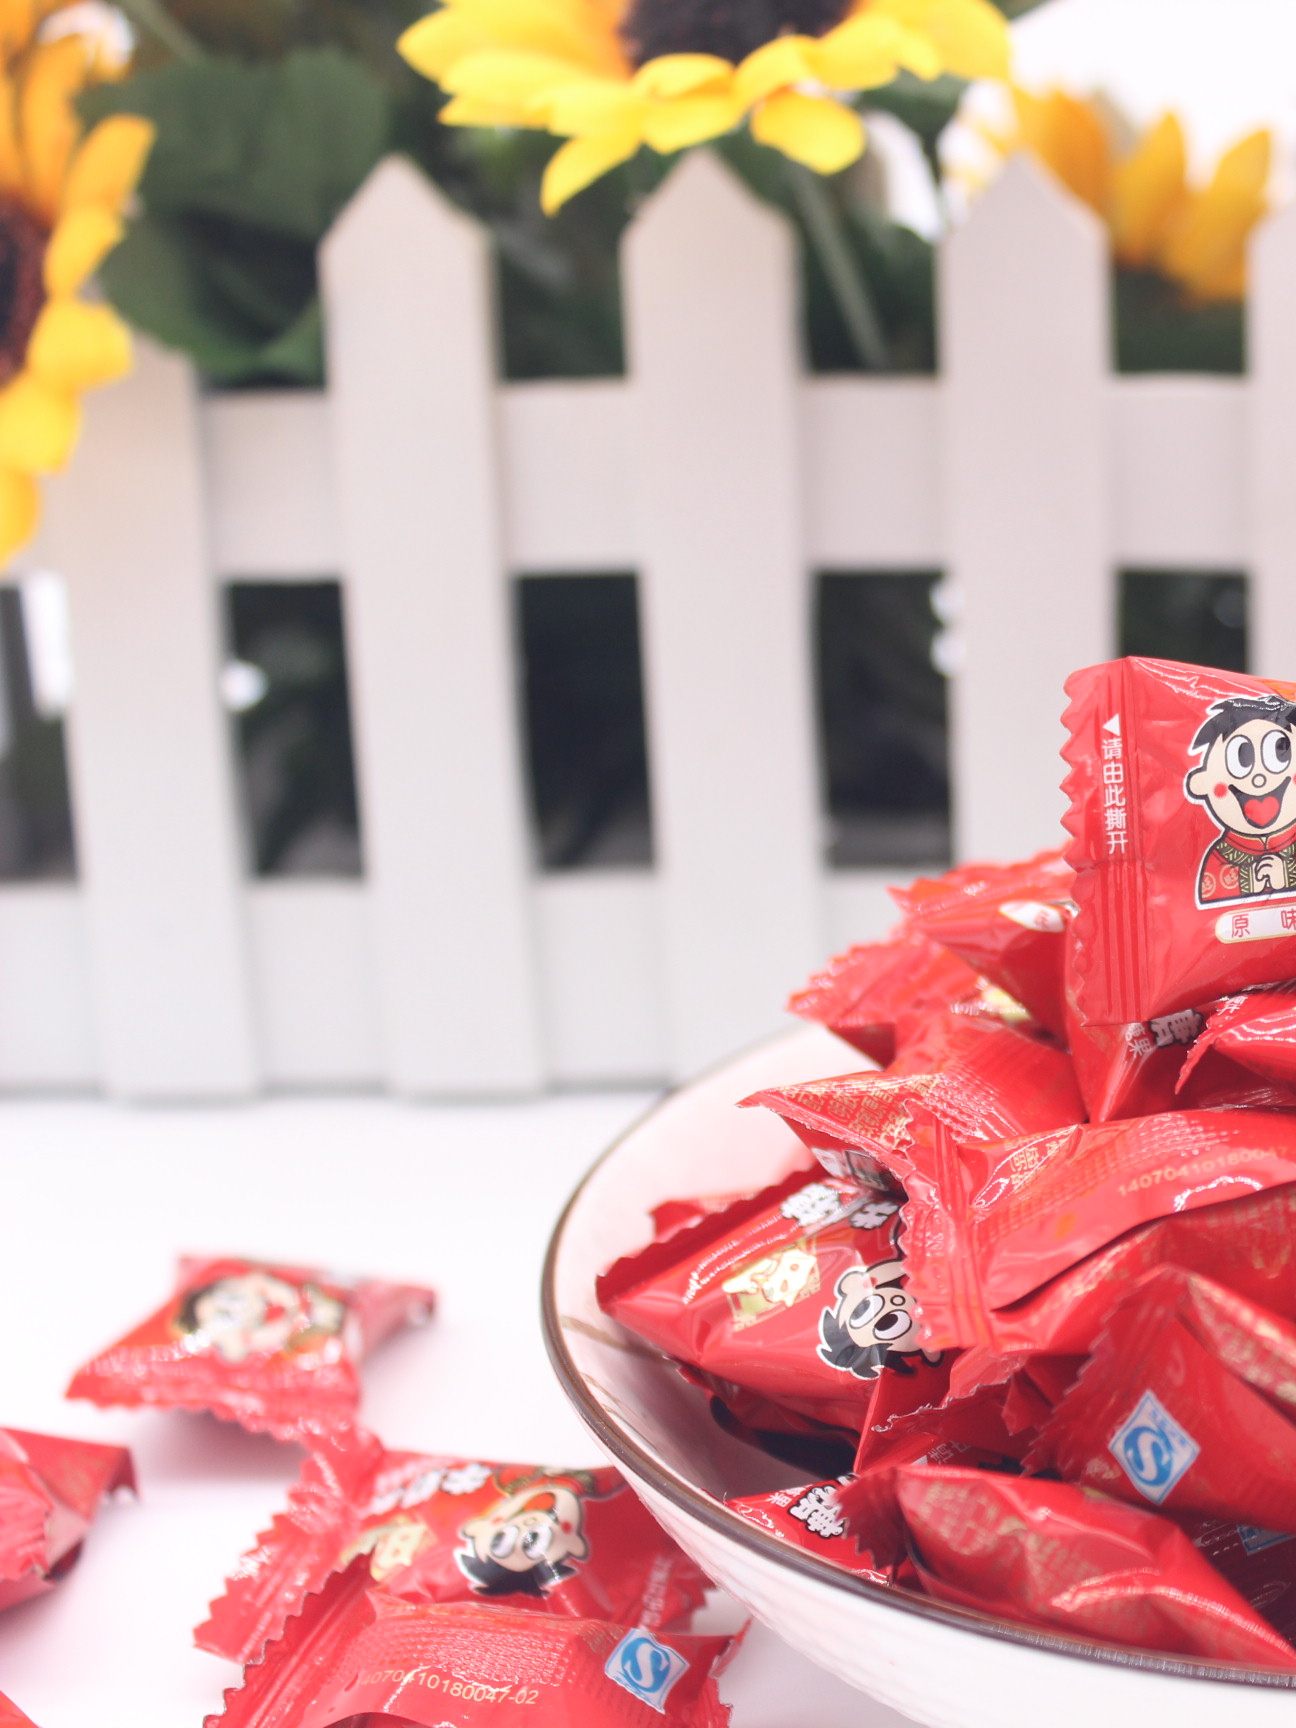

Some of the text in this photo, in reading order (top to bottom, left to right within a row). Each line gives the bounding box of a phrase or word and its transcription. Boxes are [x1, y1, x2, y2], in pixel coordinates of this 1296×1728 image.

[1100, 738, 1130, 854] 请由此撕开
